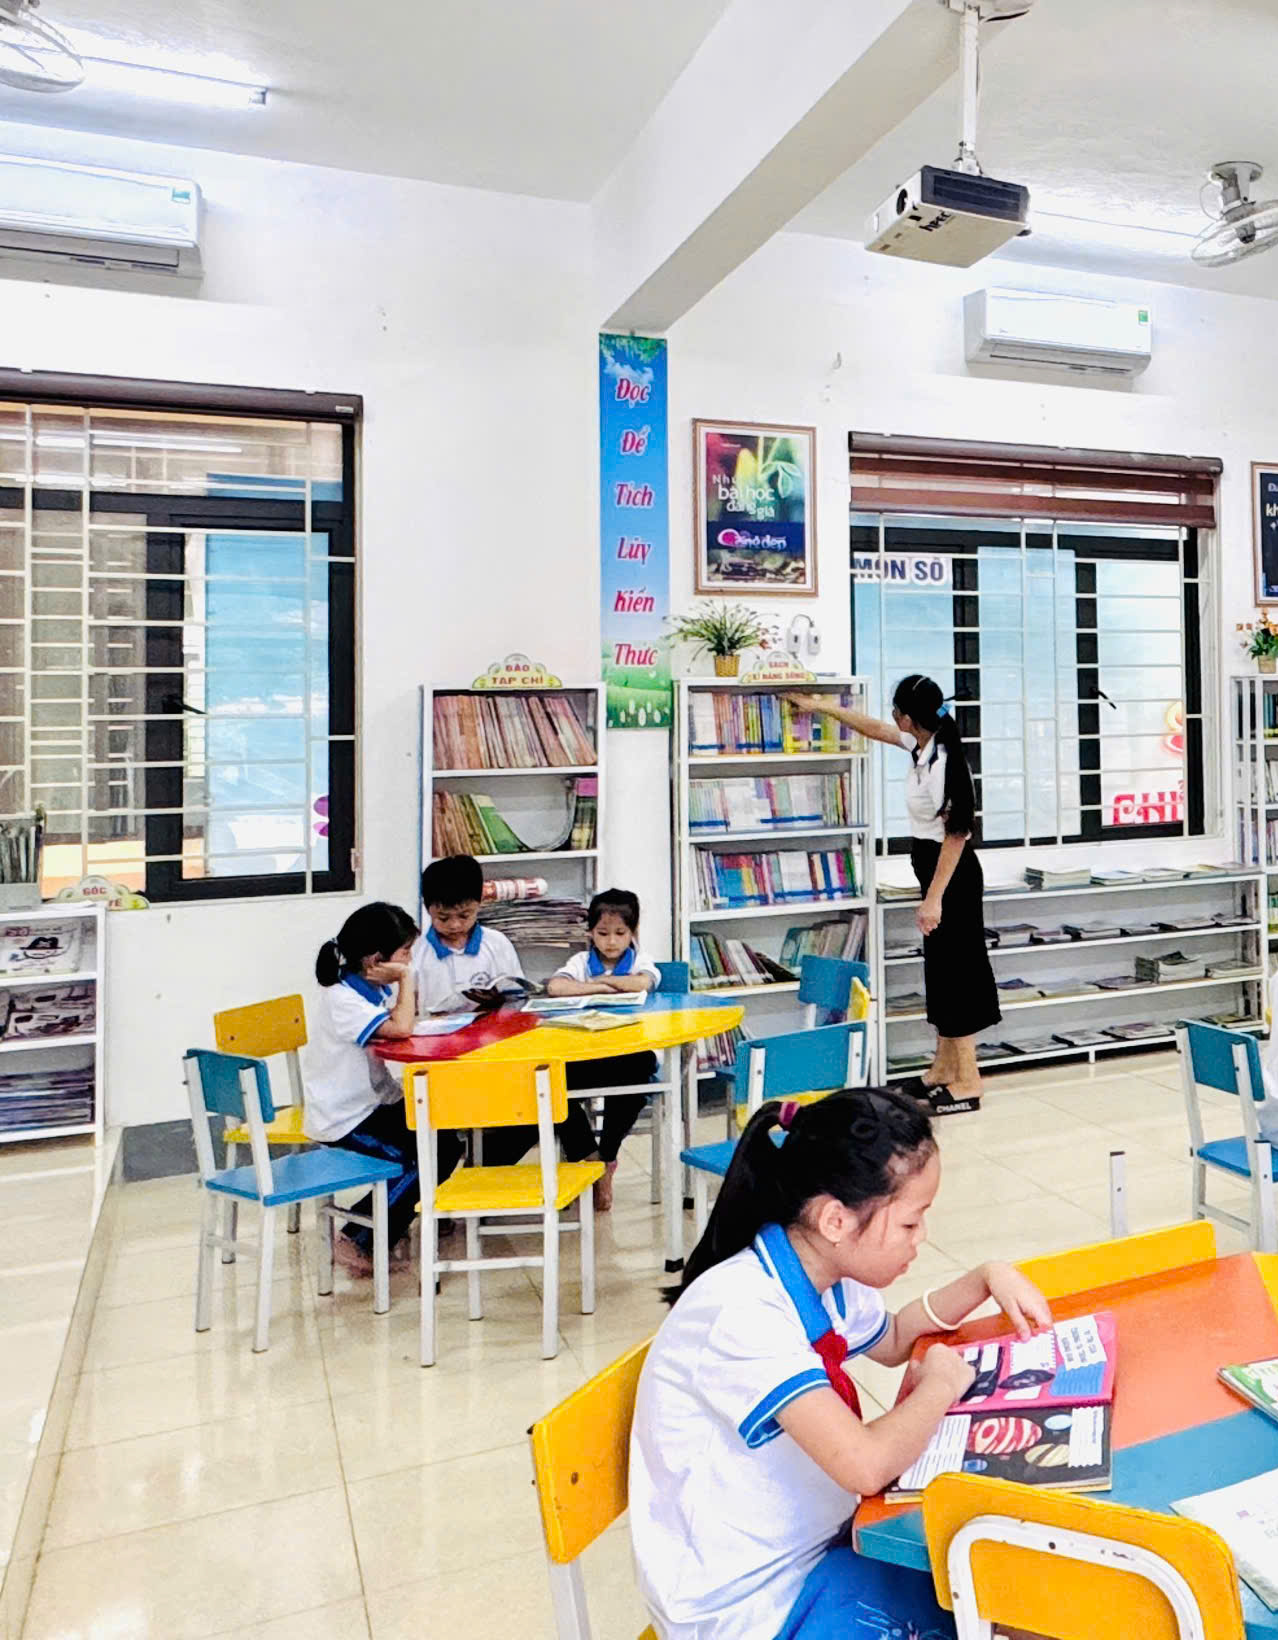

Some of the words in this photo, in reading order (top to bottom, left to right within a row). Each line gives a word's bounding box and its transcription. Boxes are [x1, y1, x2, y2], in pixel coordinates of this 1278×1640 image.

[616, 378, 650, 407] Đọc
[616, 483, 653, 507] Tích
[614, 586, 655, 612] Kiến
[936, 1101, 972, 1114] CHANEL
